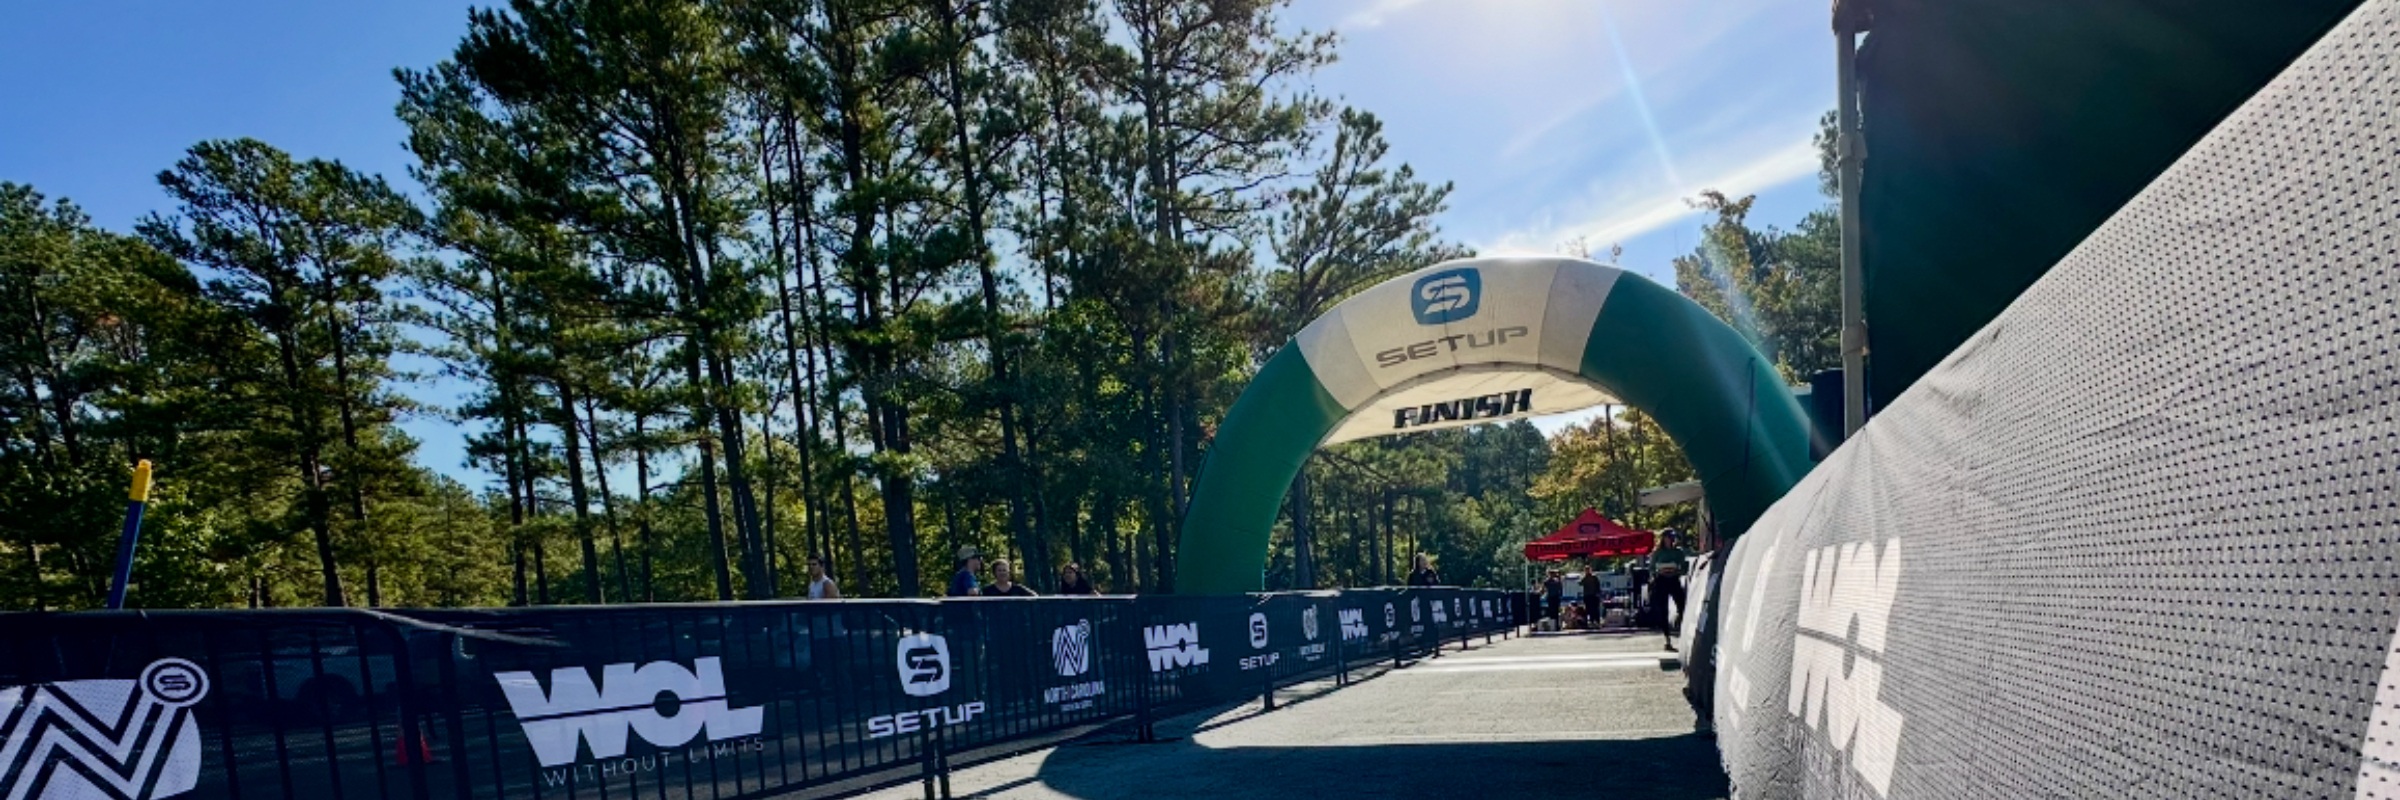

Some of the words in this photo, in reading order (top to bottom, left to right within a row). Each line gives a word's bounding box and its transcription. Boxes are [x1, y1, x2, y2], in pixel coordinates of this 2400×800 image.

[1376, 326, 1528, 368] SETUP
[1393, 388, 1532, 428] FINISH
[1144, 622, 1209, 672] WOL
[1239, 652, 1279, 670] SETUP
[1788, 536, 1903, 799] WOL
[493, 656, 764, 767] WOL
[868, 701, 985, 738] SETUP
[542, 752, 671, 787] WITHOUT
[689, 737, 765, 764] LIMITS
